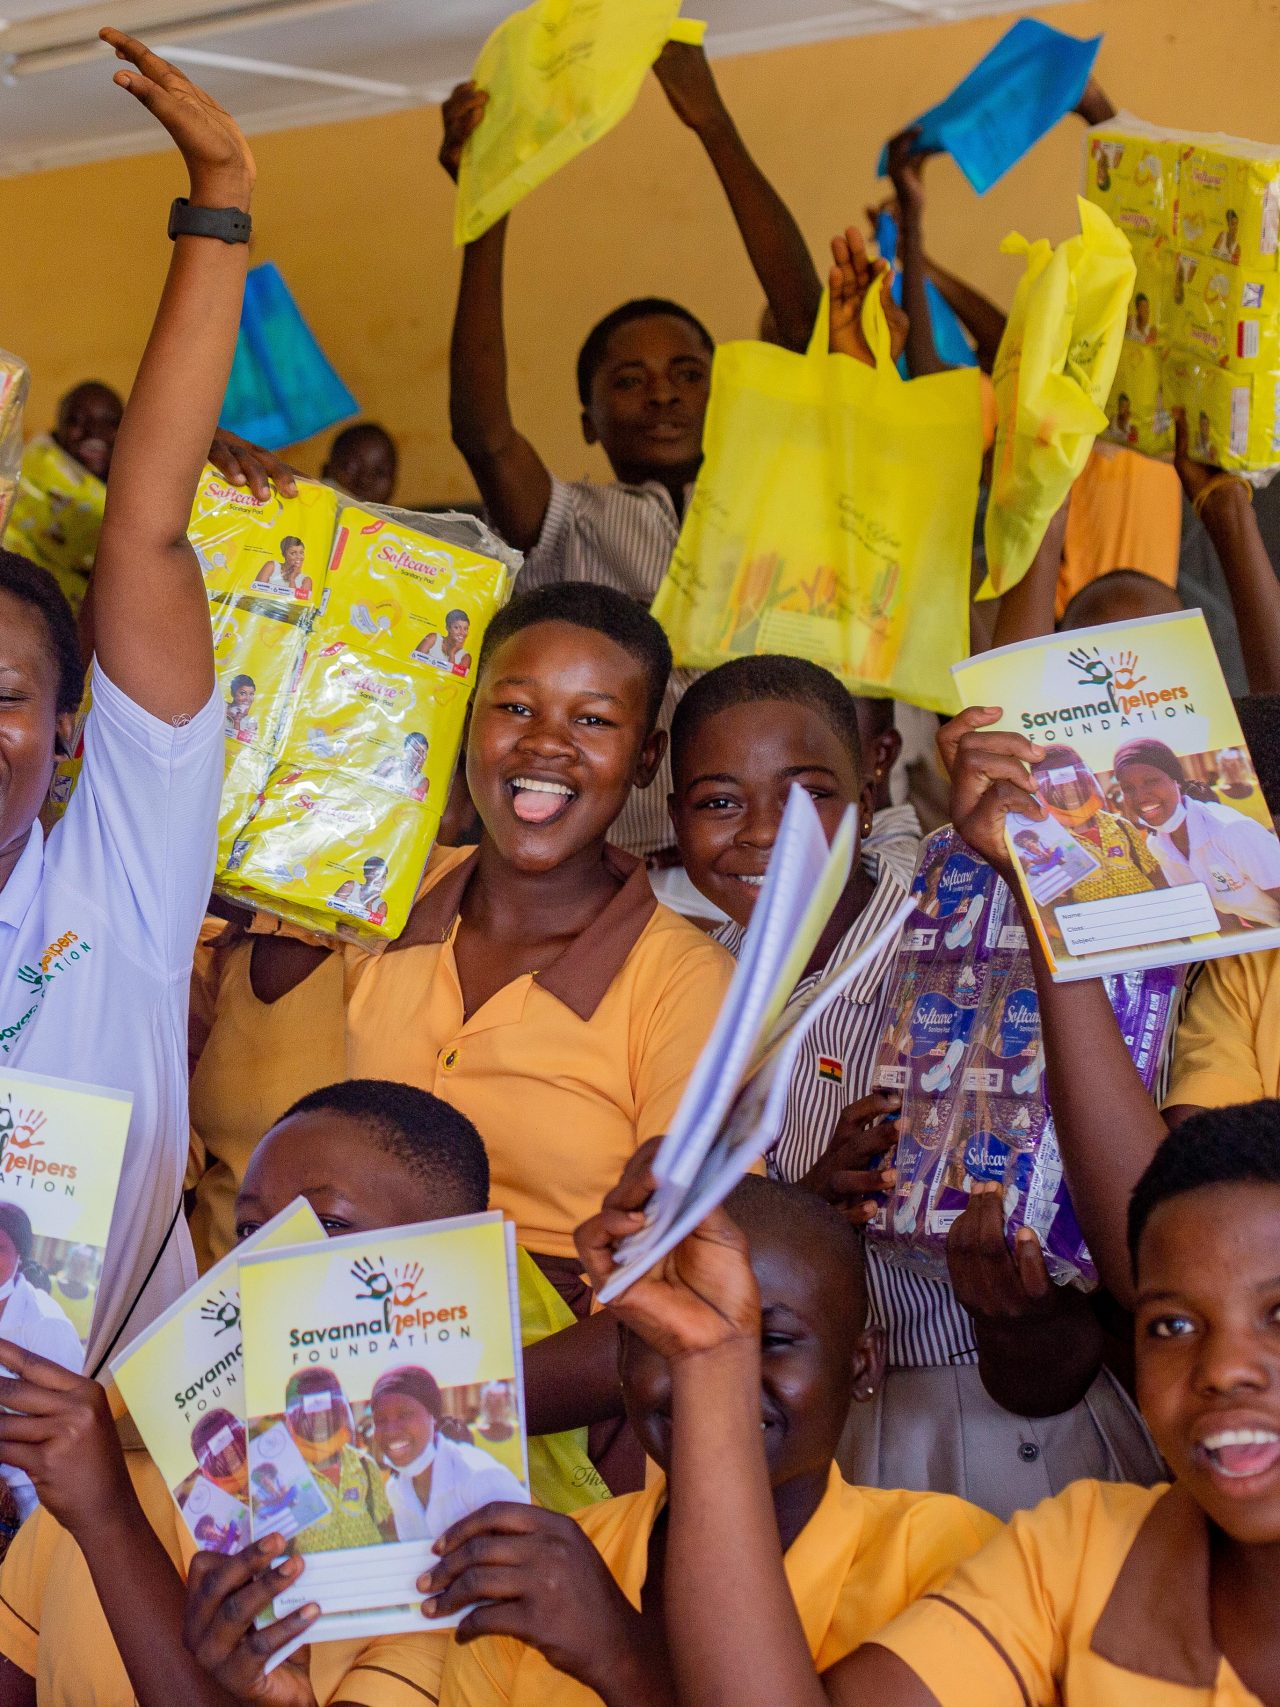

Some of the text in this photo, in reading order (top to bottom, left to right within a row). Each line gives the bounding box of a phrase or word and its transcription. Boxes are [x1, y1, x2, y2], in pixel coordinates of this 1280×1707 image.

[377, 546, 438, 577] Softcare
[401, 569, 423, 582] Sanitary
[1029, 703, 1196, 742] FOUNDATION
[913, 1007, 953, 1029] Softcare
[1004, 1005, 1041, 1028] Softca
[292, 1325, 471, 1366] FOUNDATION
